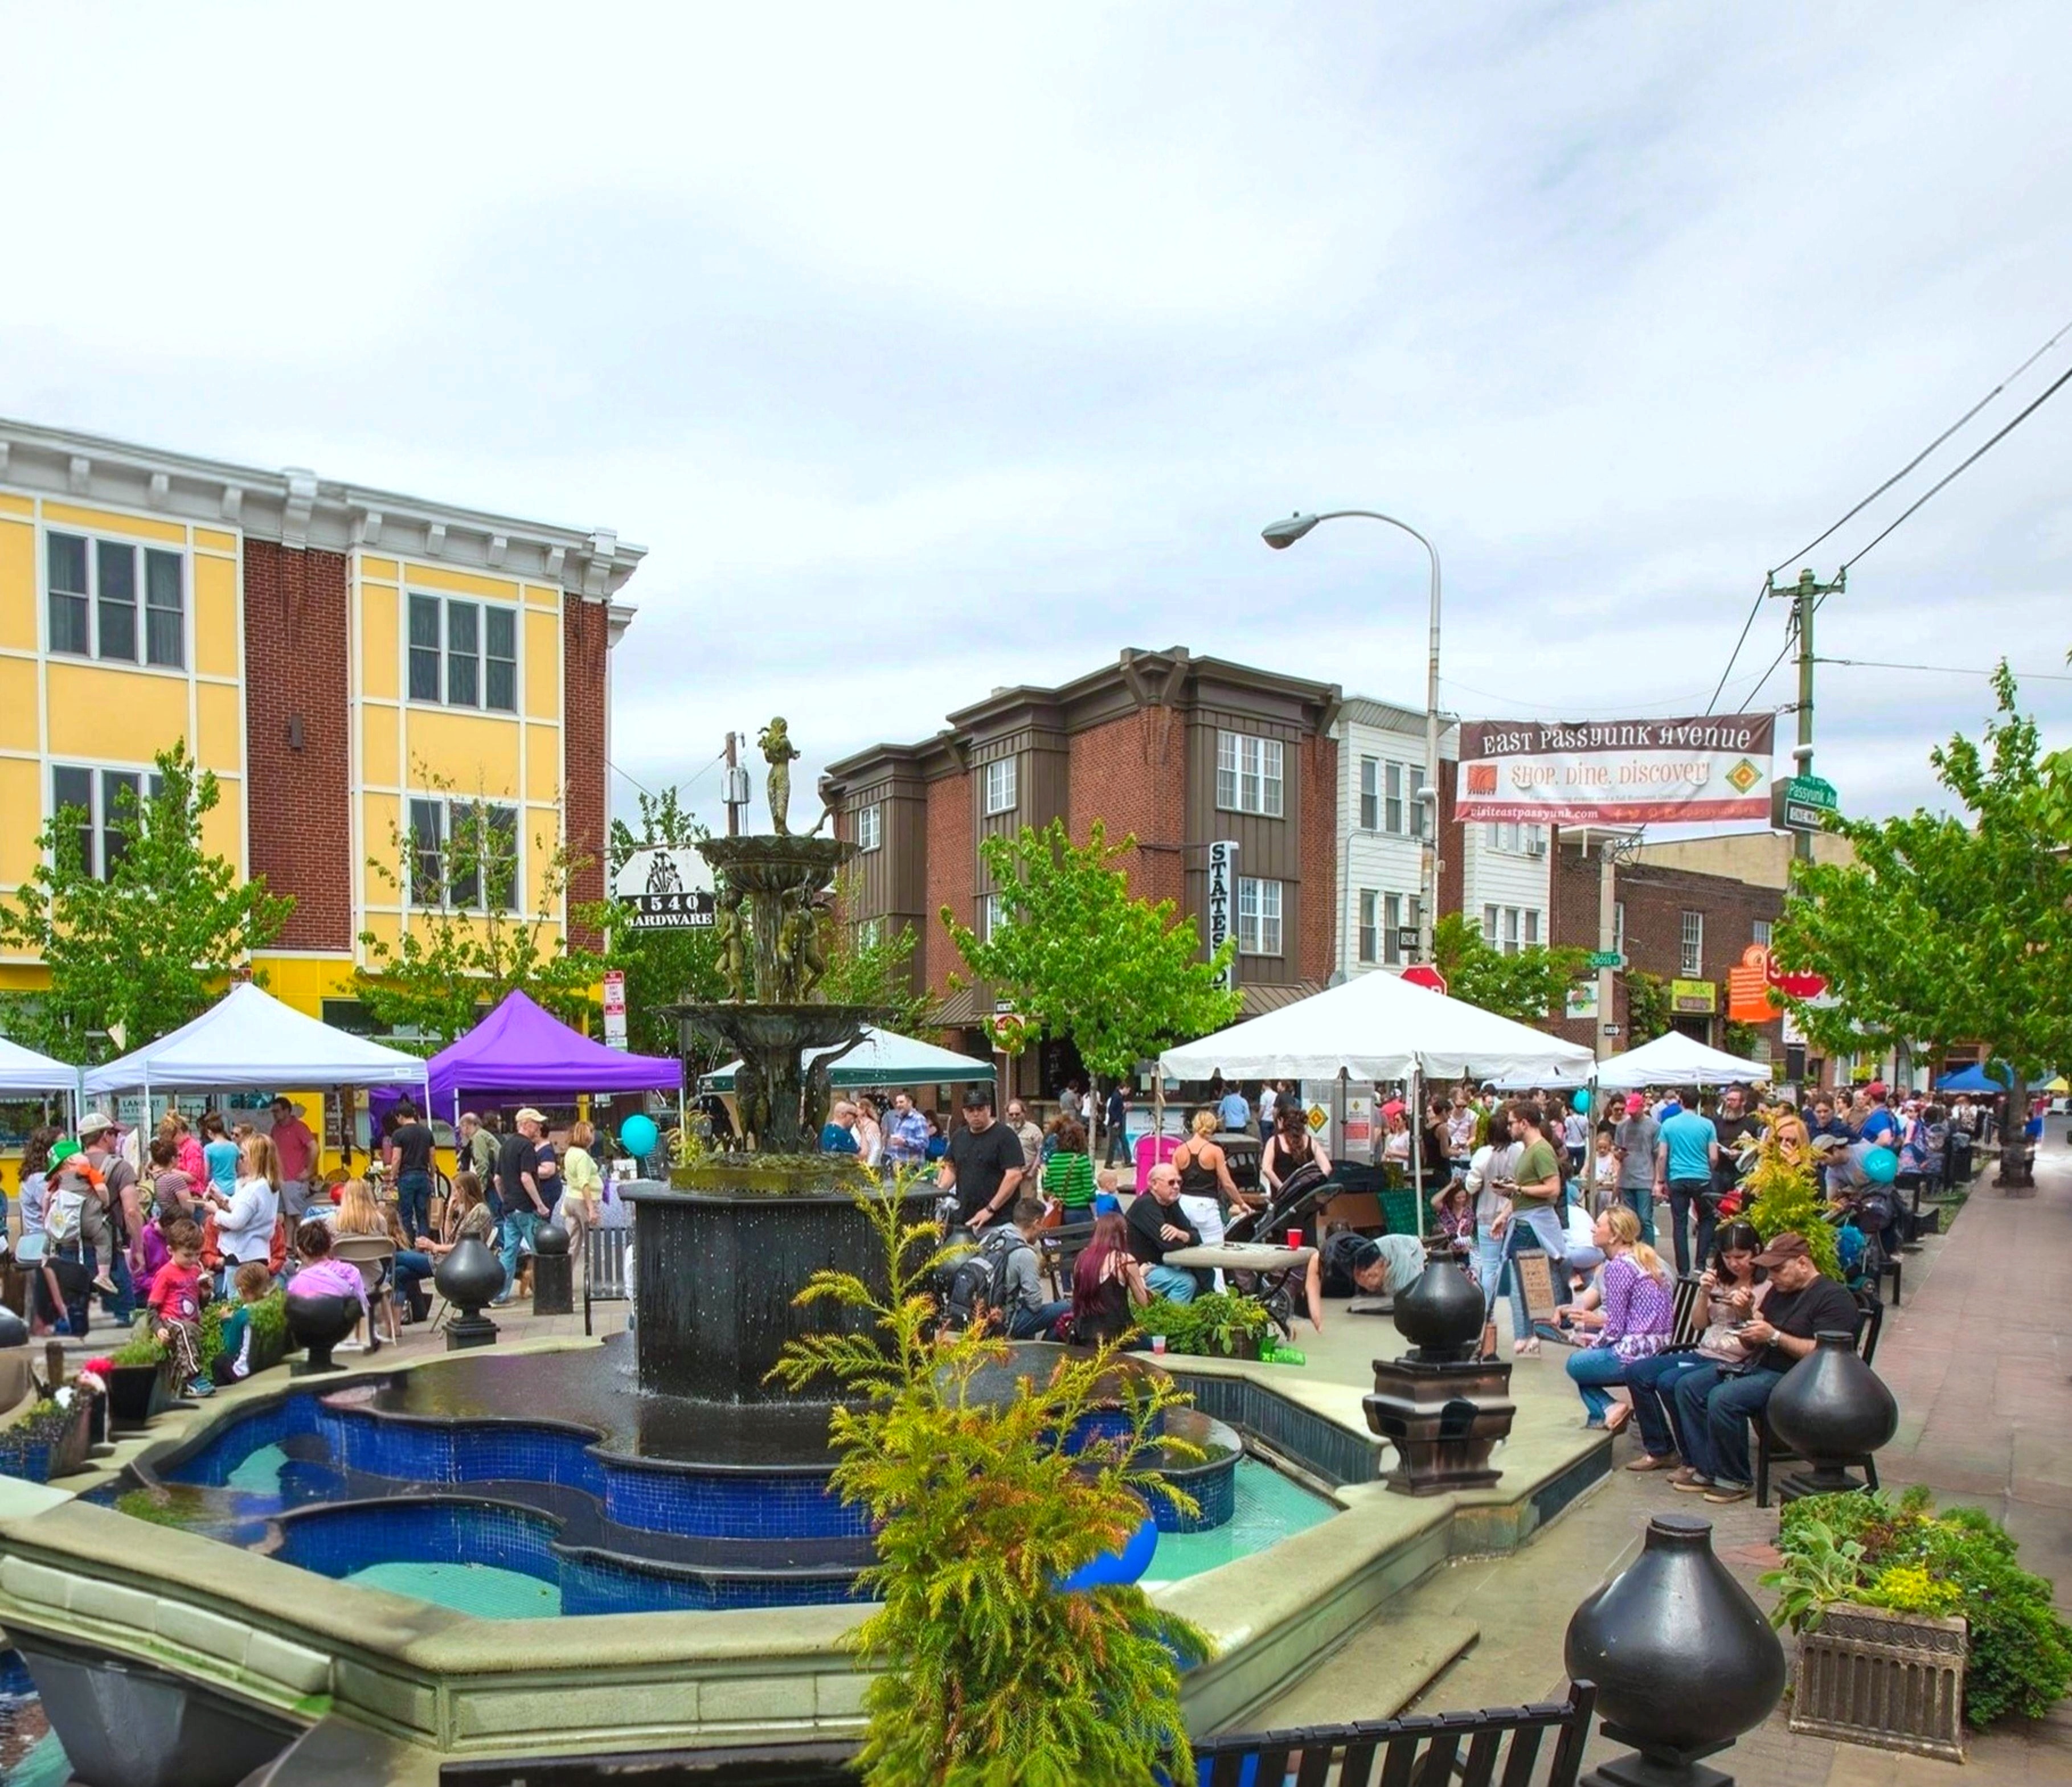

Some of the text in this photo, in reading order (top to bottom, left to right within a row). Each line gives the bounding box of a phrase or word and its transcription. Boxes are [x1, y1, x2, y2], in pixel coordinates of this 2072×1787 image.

[1471, 806, 1598, 820] visiteastpassyunk.com
[634, 895, 699, 912] 1540
[1210, 844, 1228, 991] STATESD
